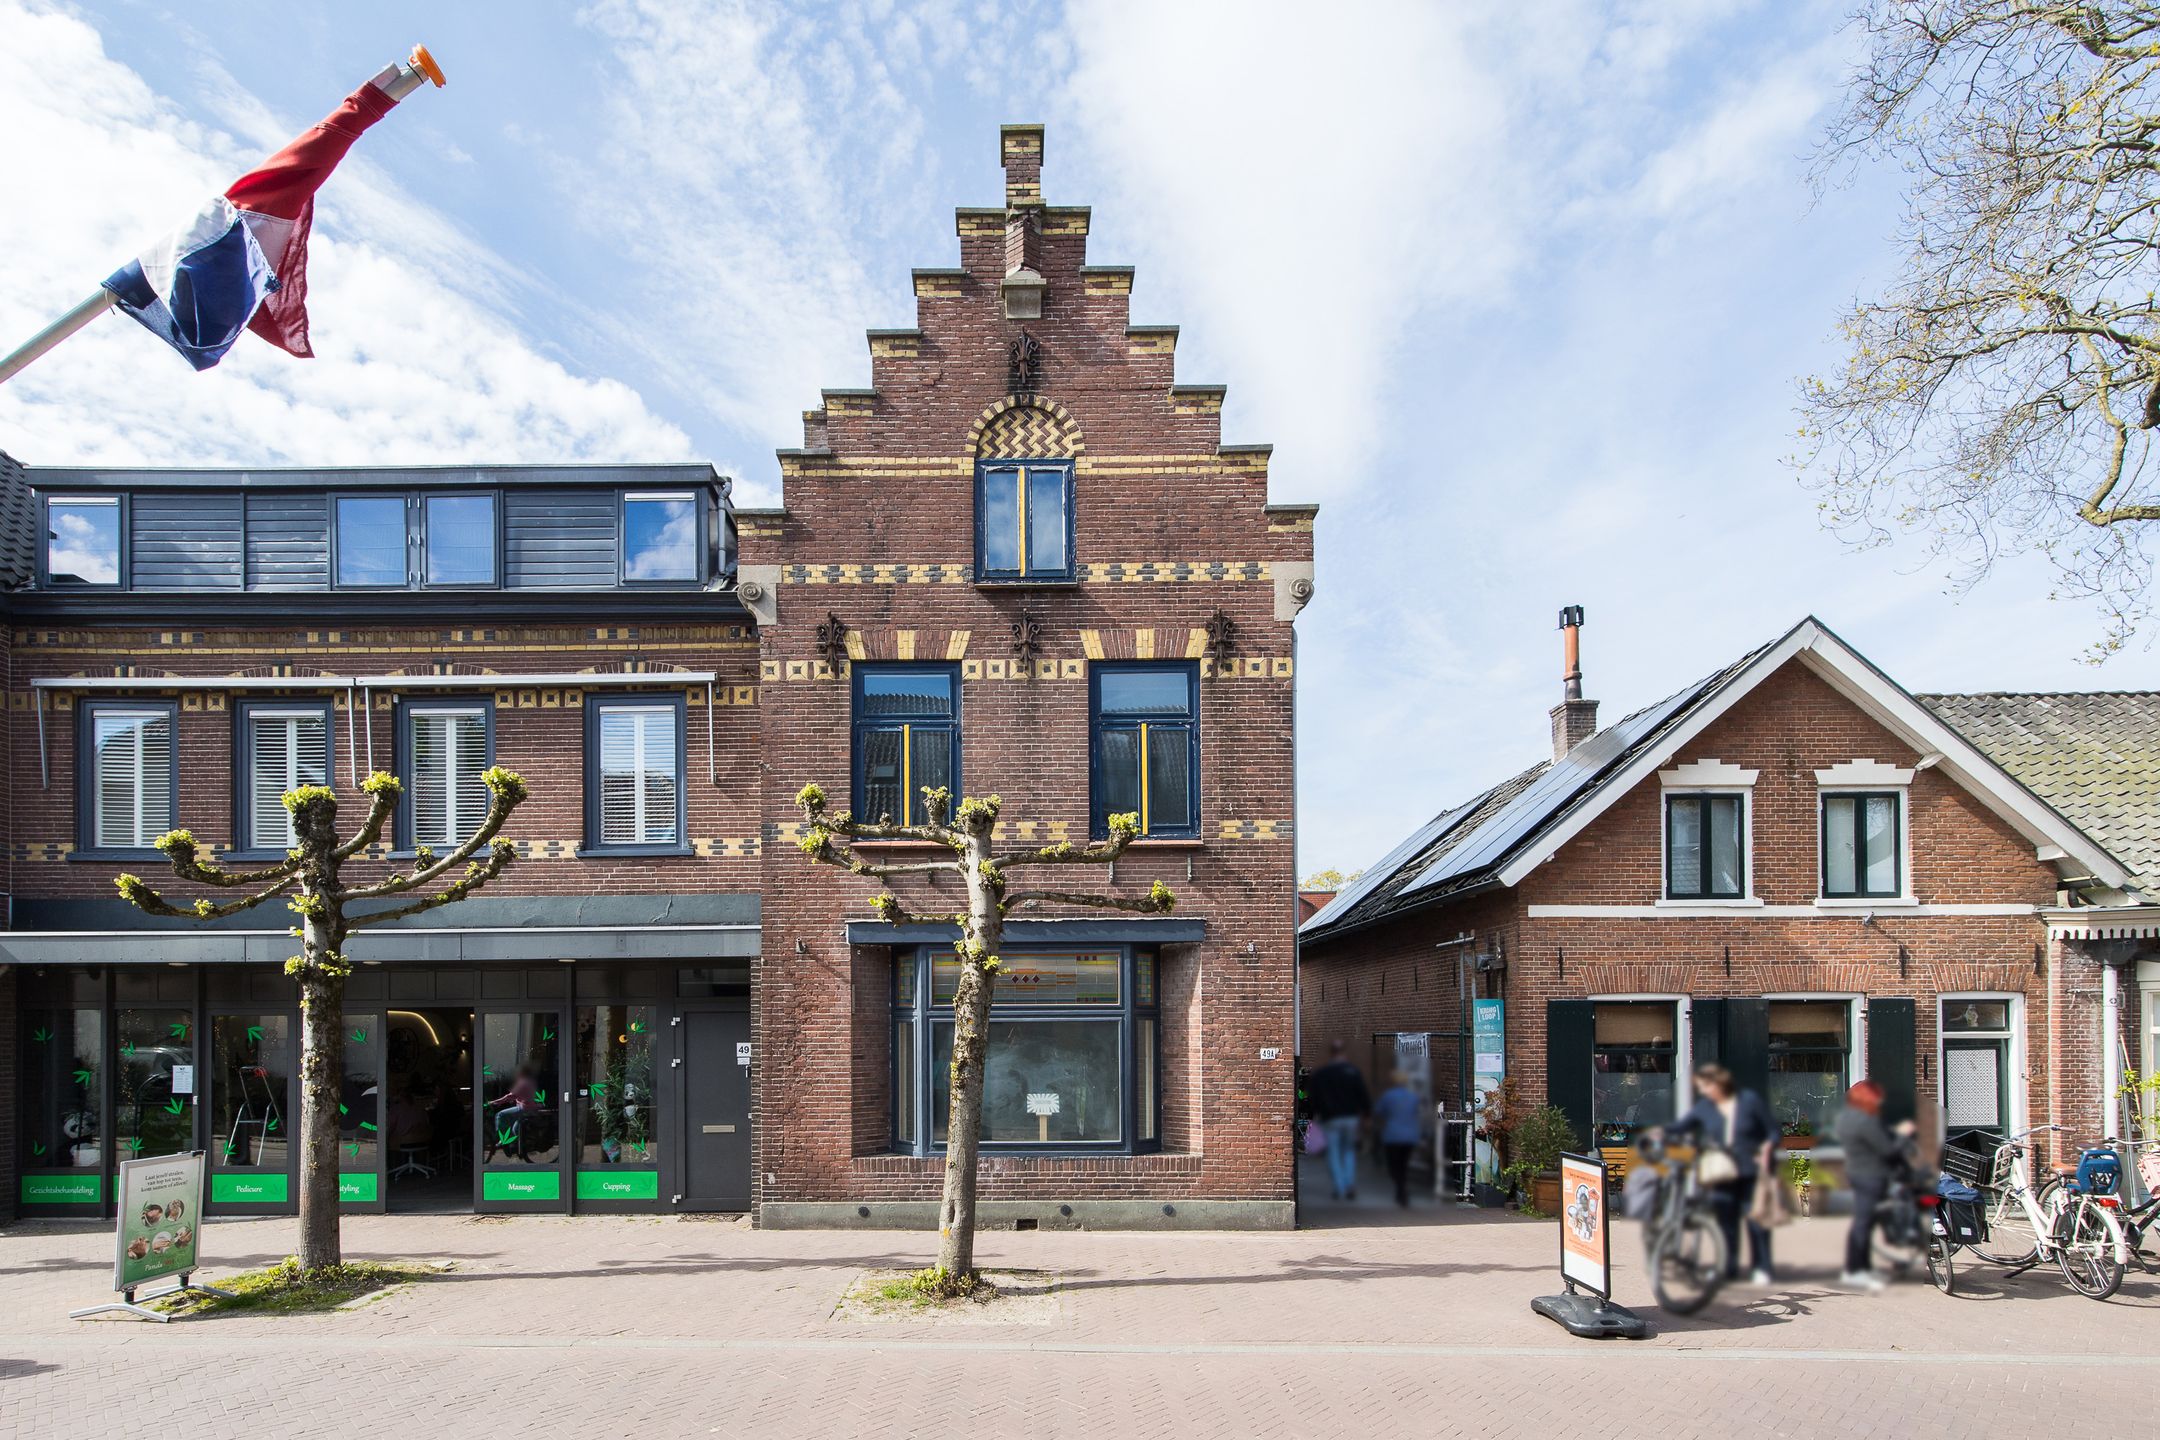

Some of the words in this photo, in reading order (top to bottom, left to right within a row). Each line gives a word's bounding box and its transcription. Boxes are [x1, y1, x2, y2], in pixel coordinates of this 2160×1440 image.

[1481, 1013, 1497, 1021] LOOP
[738, 1045, 750, 1054] 49
[1262, 1049, 1275, 1058] 49A
[29, 1185, 94, 1197] Gezichtsbehandeling
[235, 1184, 263, 1193] Pedicure
[507, 1182, 536, 1193] Massage
[602, 1181, 632, 1192] Cupping
